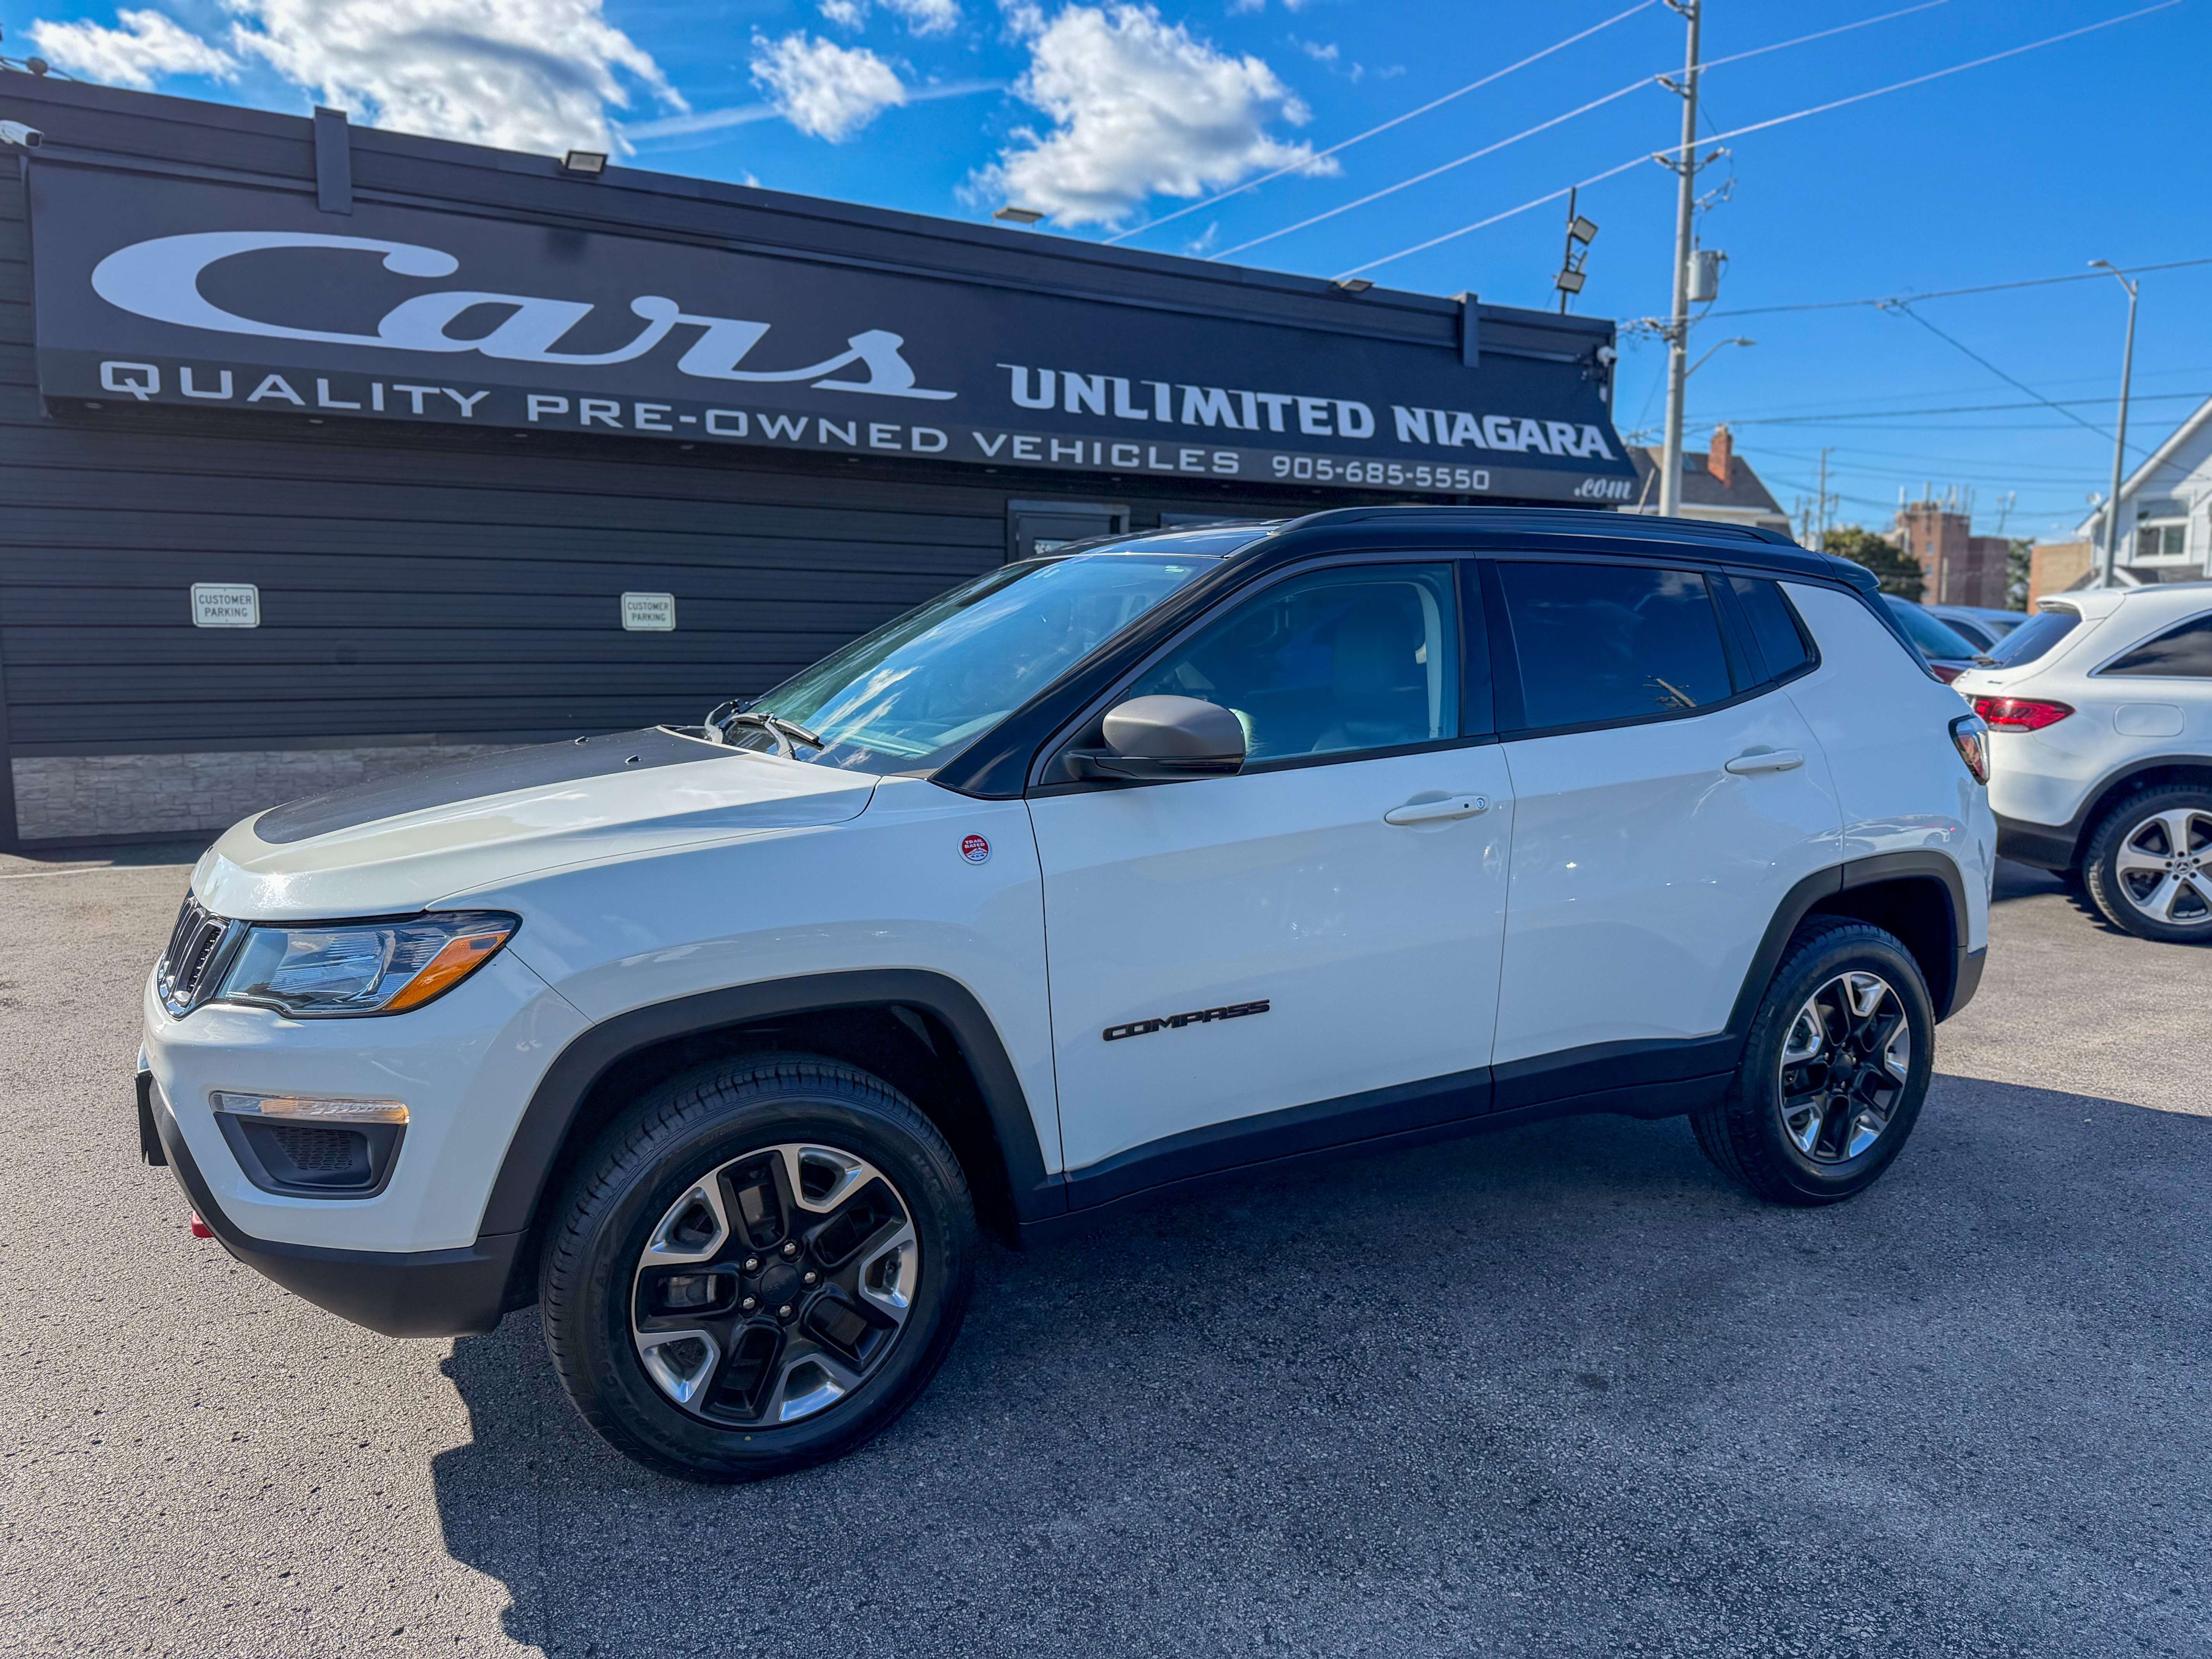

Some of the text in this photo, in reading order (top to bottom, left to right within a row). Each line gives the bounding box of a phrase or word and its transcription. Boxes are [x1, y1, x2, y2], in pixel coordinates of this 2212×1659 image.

[92, 232, 957, 400] Cars
[101, 361, 1239, 473] QUALITY PRE-OWNED VEHICLES
[997, 364, 1617, 459] UNLIMITED NIAGARA
[1273, 456, 1489, 489] 905-685-5550
[1574, 477, 1632, 500] .com
[199, 595, 252, 605] CUSTOMER
[204, 607, 248, 617] PARKING
[627, 602, 669, 610] CUSTOMER
[632, 613, 666, 621] PARKING
[1103, 999, 1270, 1041] COMPASS
